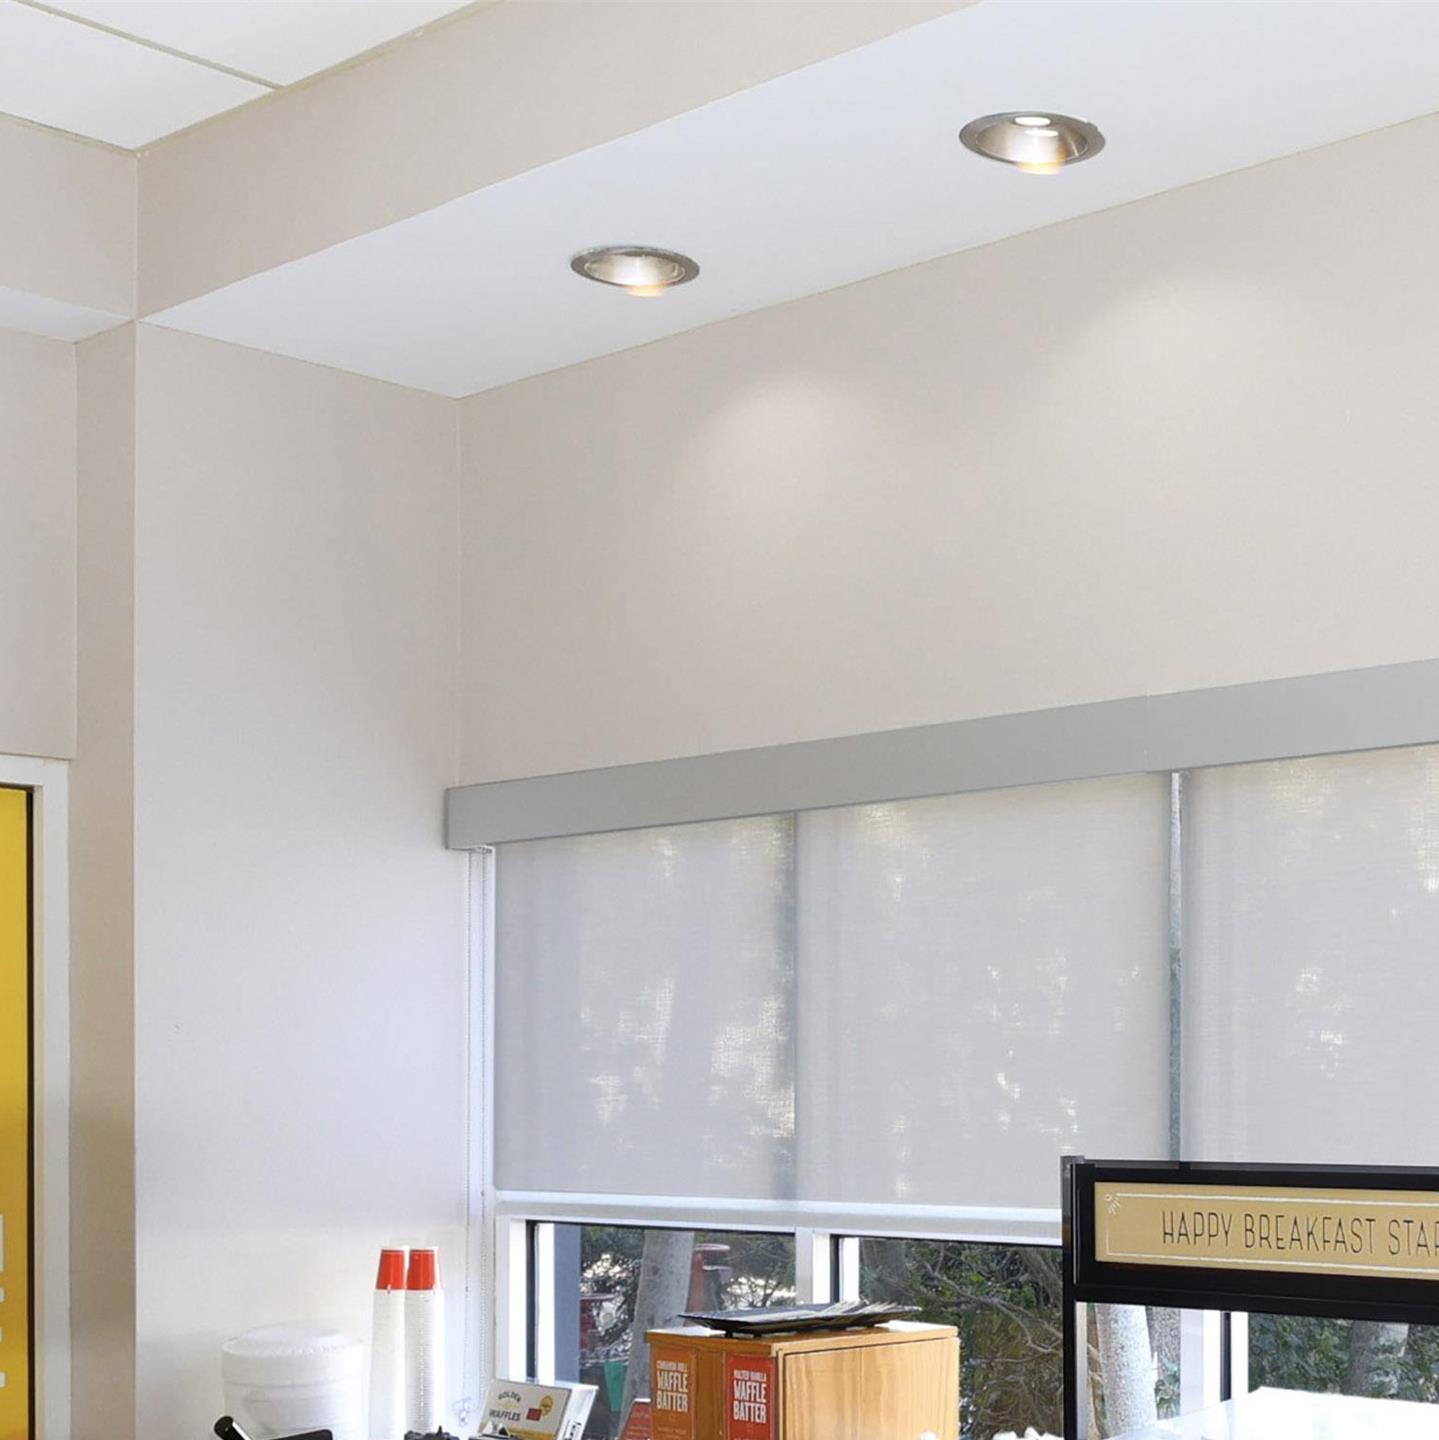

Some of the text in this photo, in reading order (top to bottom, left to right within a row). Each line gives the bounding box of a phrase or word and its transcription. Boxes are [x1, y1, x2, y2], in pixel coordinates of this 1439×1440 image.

[1161, 1210, 1233, 1247] HAPPY
[1244, 1214, 1376, 1254] BREAKFAST
[656, 1371, 688, 1393] WAFFLE
[733, 1380, 767, 1403] WAFFLE
[656, 1390, 688, 1413] BATTER
[733, 1400, 767, 1424] BATTER
